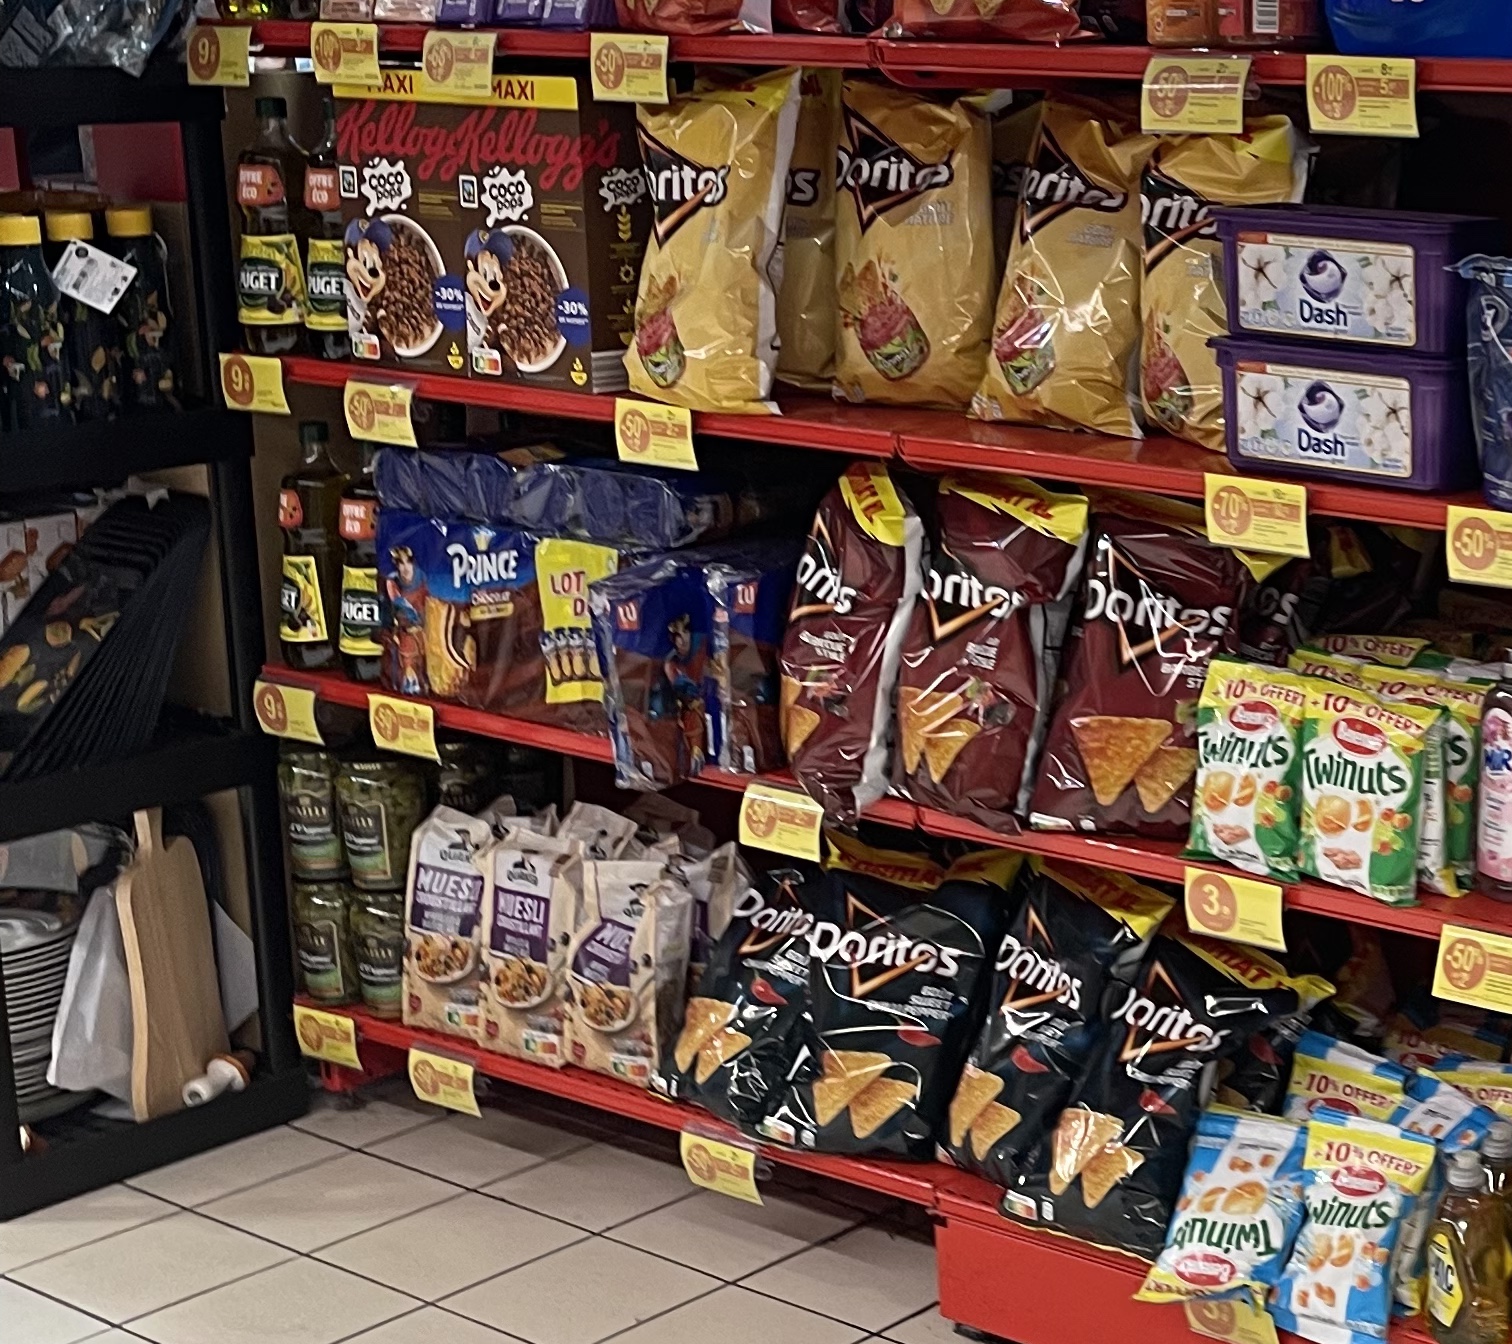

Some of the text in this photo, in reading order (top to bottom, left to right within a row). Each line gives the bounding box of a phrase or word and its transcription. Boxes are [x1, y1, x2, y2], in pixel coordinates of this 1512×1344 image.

[368, 172, 405, 189] COCO
[488, 181, 526, 198] COCO
[1300, 298, 1348, 328] Dash
[1297, 428, 1345, 459] Dash
[446, 544, 518, 588] PRINCE
[551, 571, 585, 595] LOT
[1303, 748, 1407, 797] Twinuts
[806, 920, 959, 977] Doritos
